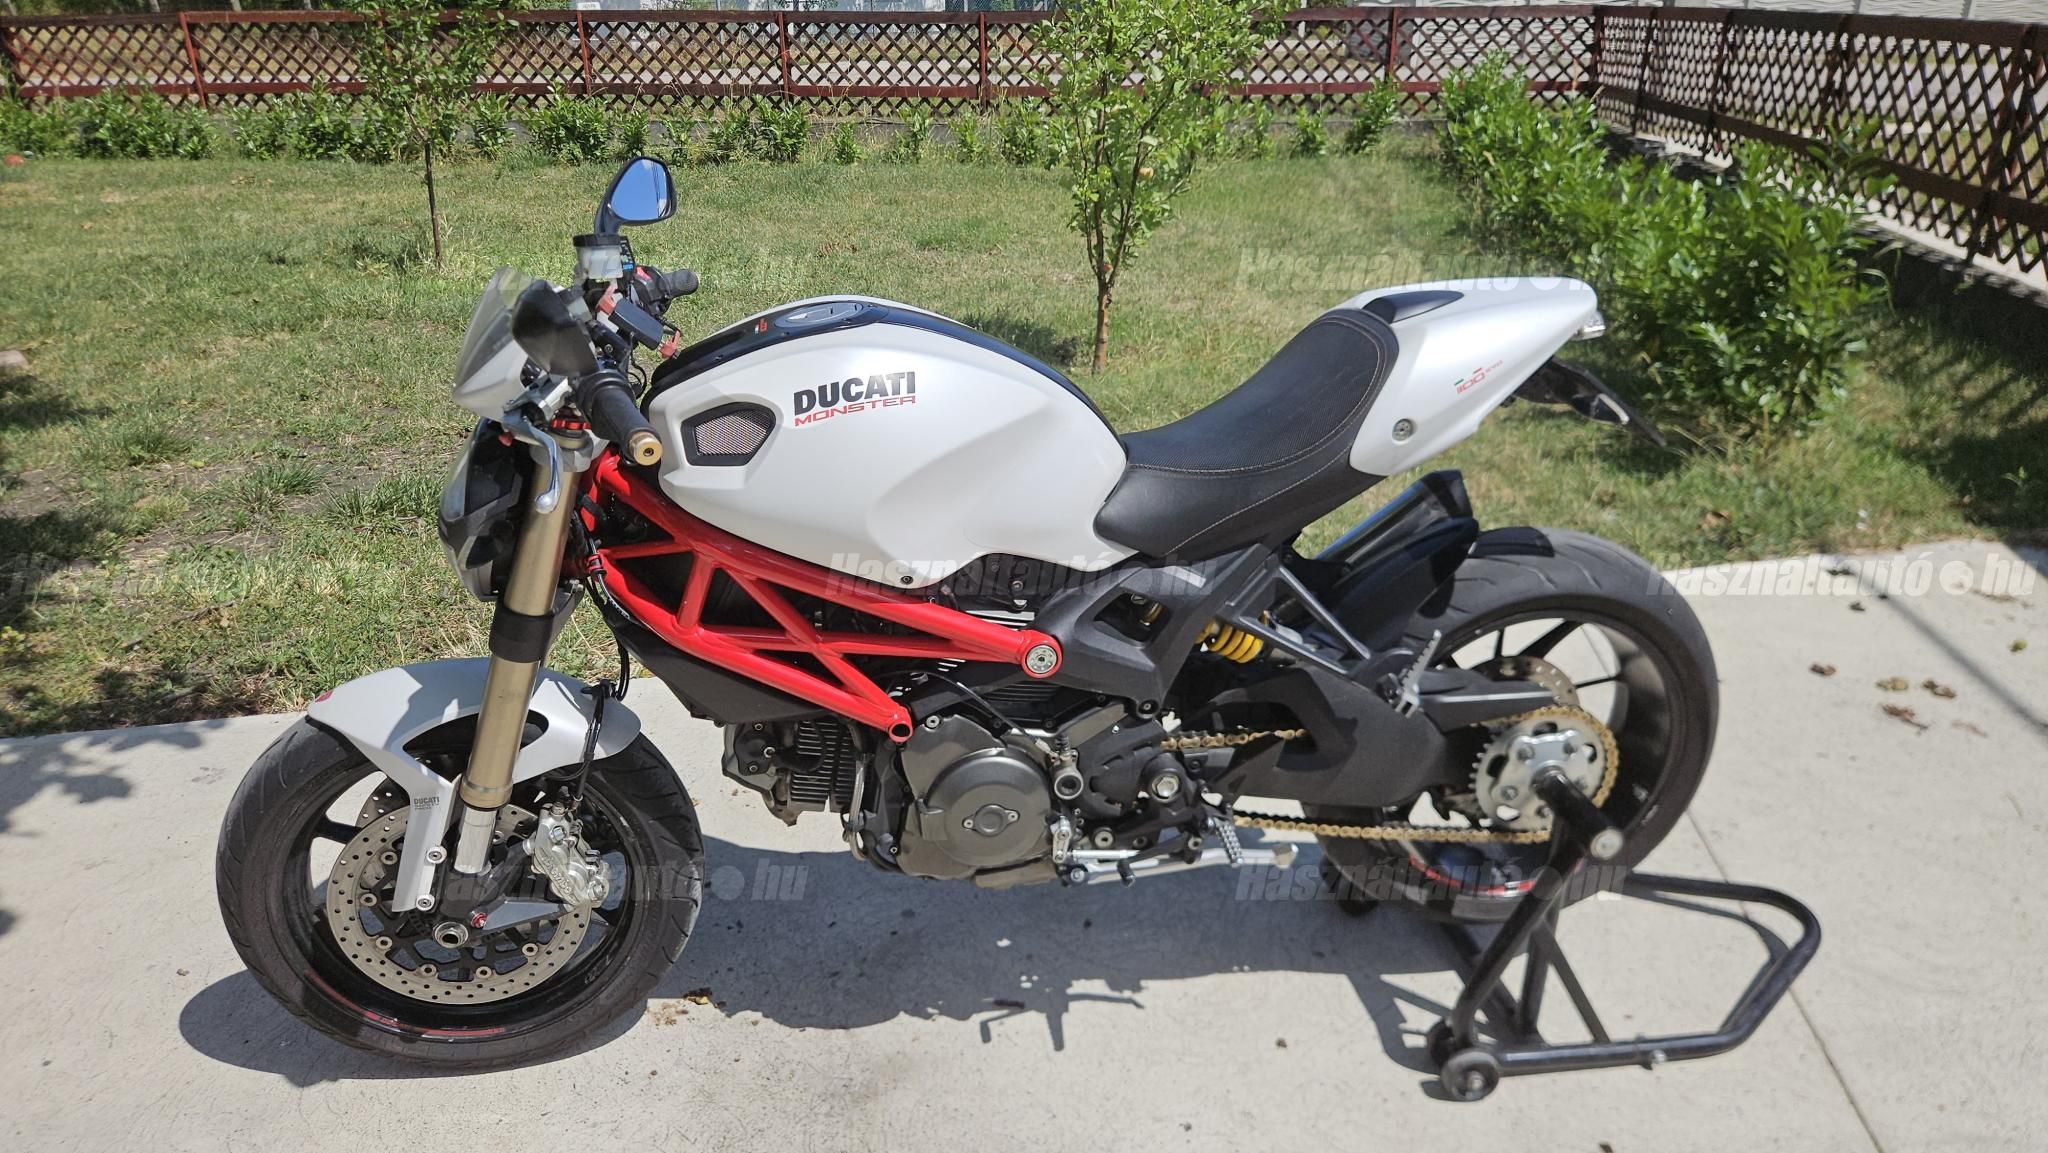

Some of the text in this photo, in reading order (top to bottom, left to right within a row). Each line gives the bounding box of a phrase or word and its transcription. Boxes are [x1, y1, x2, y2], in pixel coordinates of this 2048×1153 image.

[794, 371, 916, 416] DUCATI
[794, 395, 916, 427] MONSTER
[413, 796, 440, 805] DUCATI
